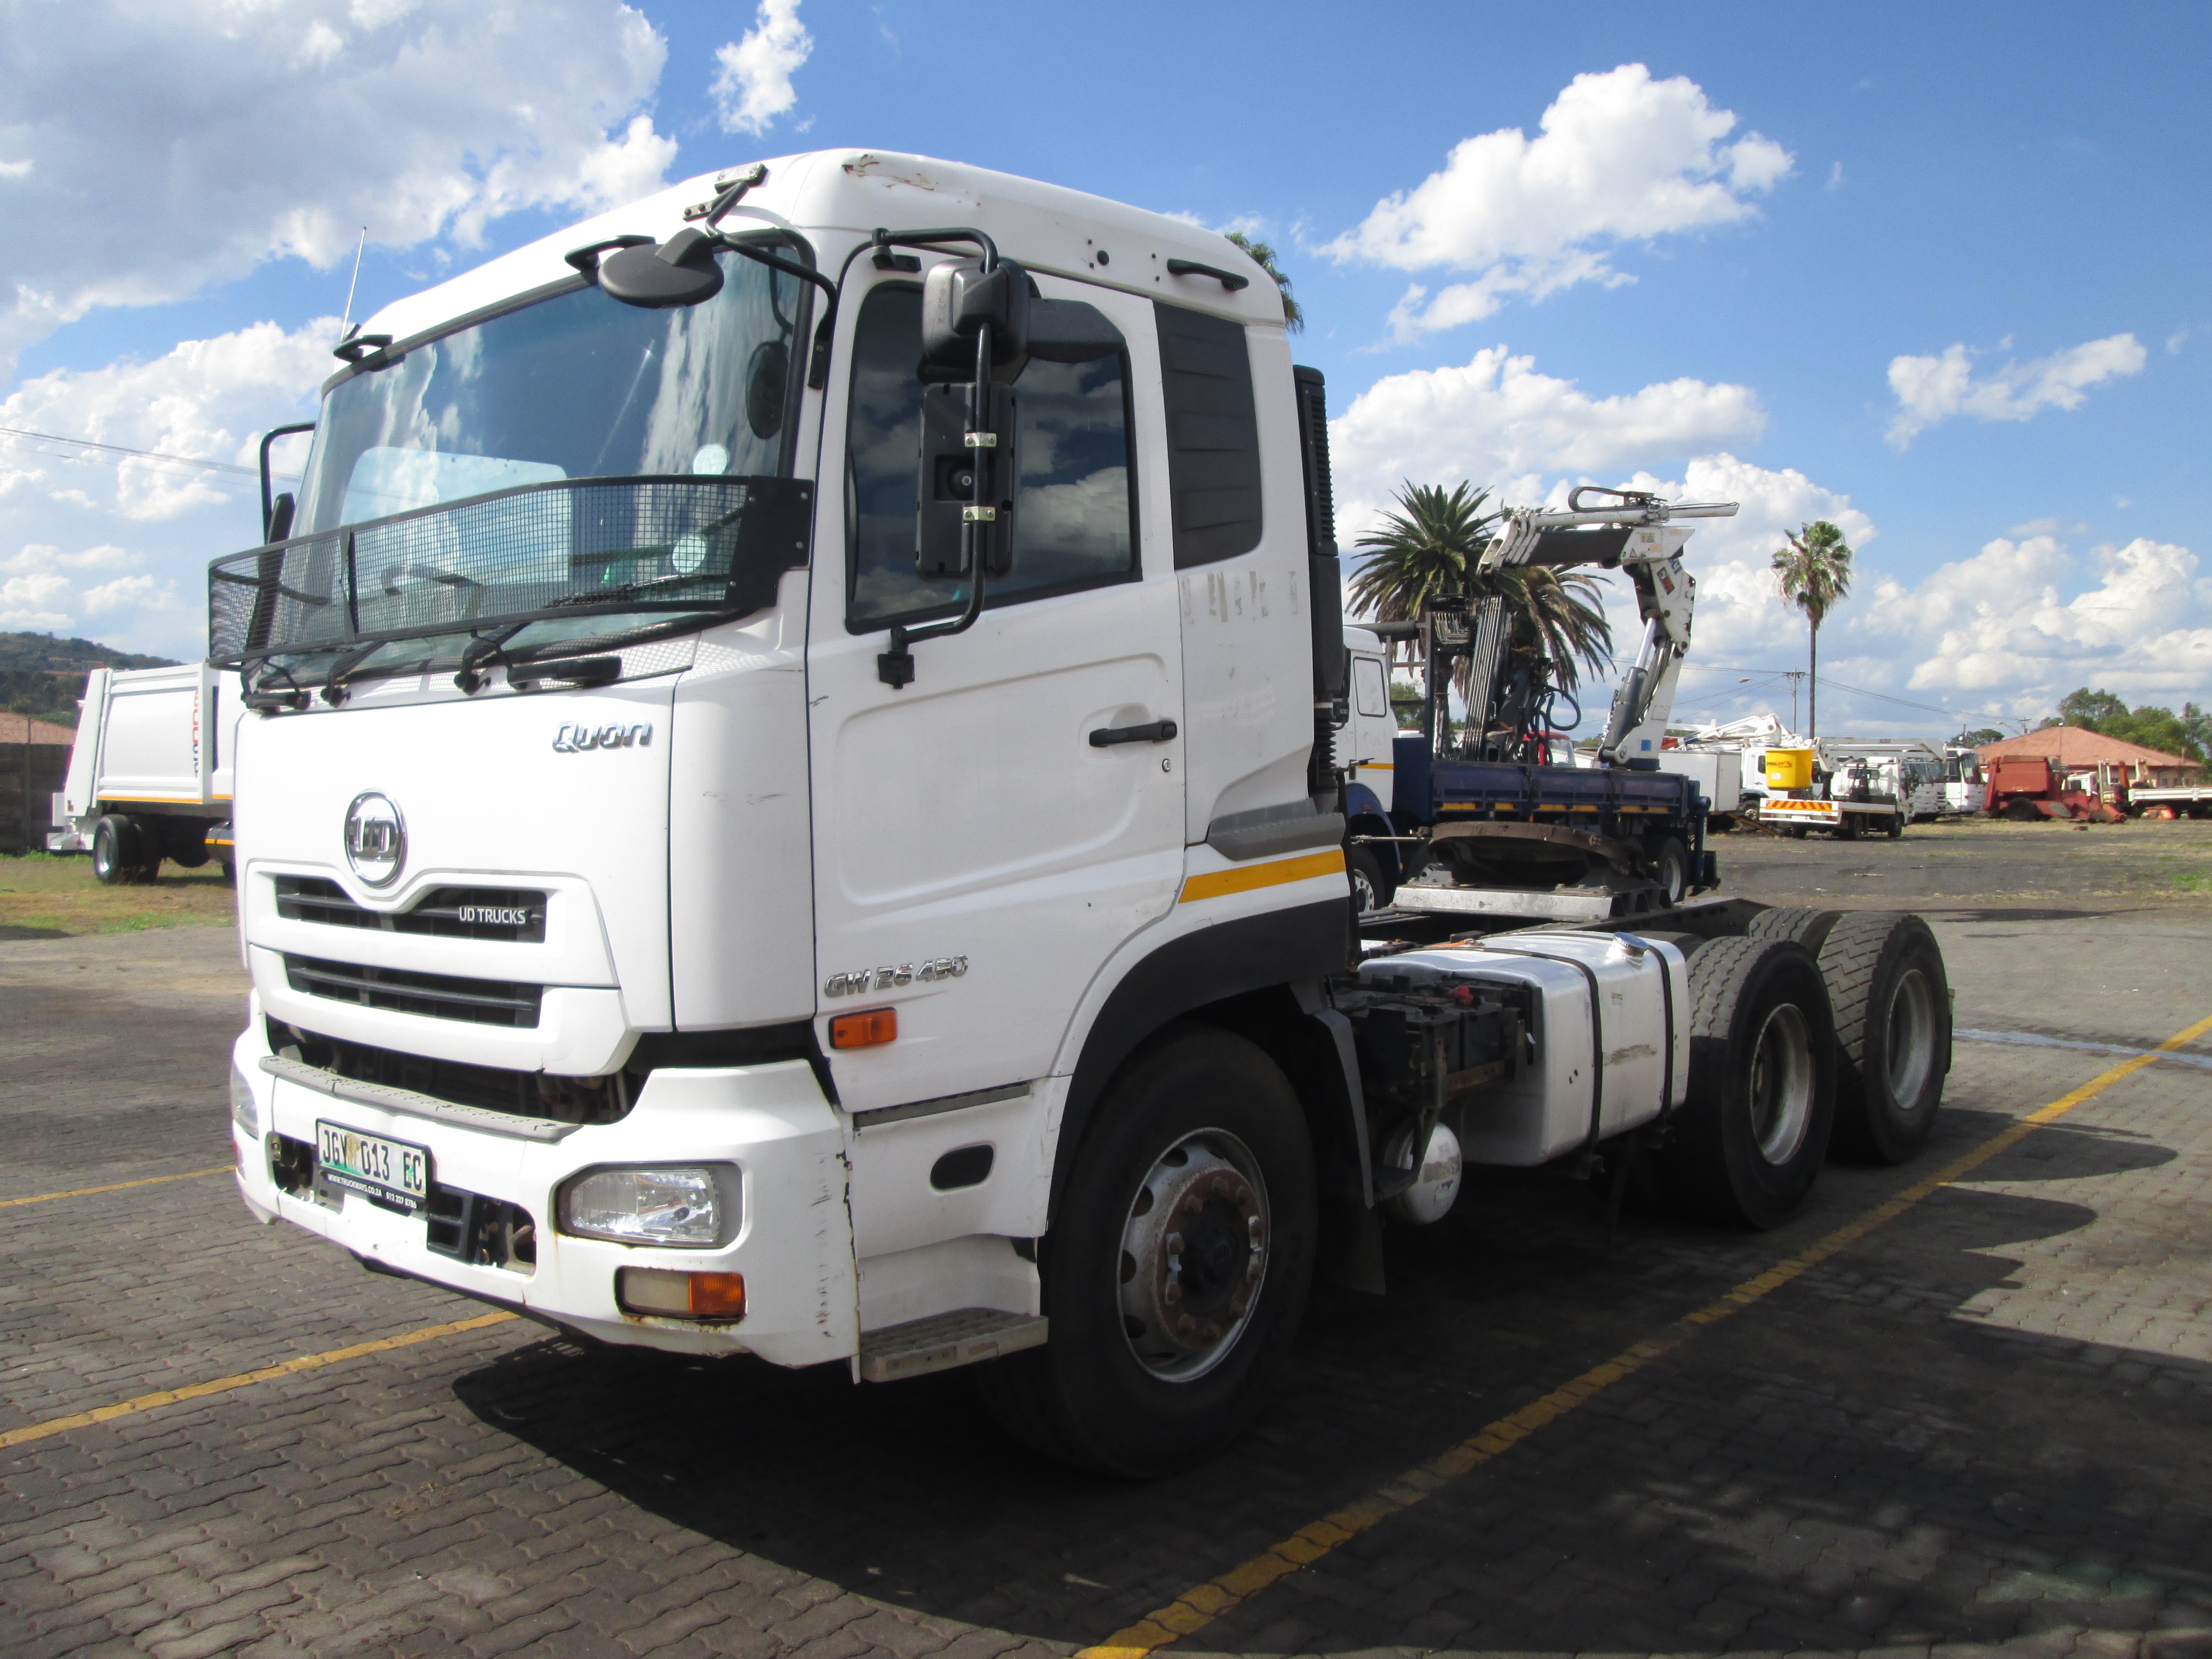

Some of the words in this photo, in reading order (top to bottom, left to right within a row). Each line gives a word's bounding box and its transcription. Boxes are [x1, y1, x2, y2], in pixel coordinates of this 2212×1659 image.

[553, 721, 653, 754] Quon
[459, 907, 475, 922] UD
[477, 908, 526, 925] TRUCKS
[824, 969, 871, 997] GW
[874, 962, 914, 990] 26
[916, 954, 969, 982] 450
[323, 1129, 347, 1168] JGY
[361, 1140, 390, 1181] 013
[403, 1151, 422, 1191] EC
